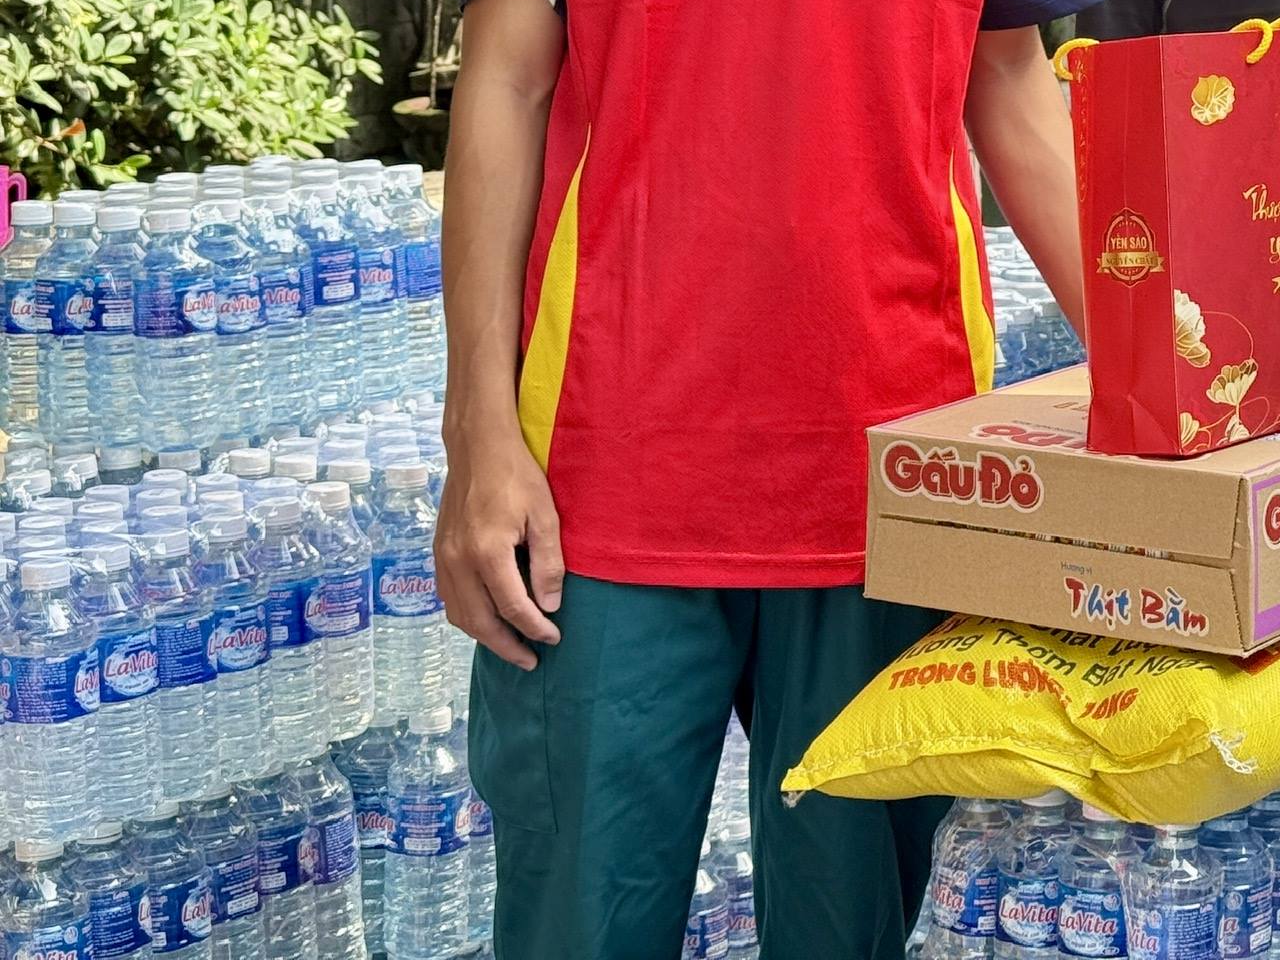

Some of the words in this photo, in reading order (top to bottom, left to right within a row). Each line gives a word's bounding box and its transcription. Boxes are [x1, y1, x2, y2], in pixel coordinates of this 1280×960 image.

[379, 574, 436, 596] LaVita
[1064, 576, 1131, 630] Thịt
[1139, 586, 1209, 636] Bằm
[1000, 901, 1058, 925] LaVita
[1058, 907, 1118, 936] LaVita
